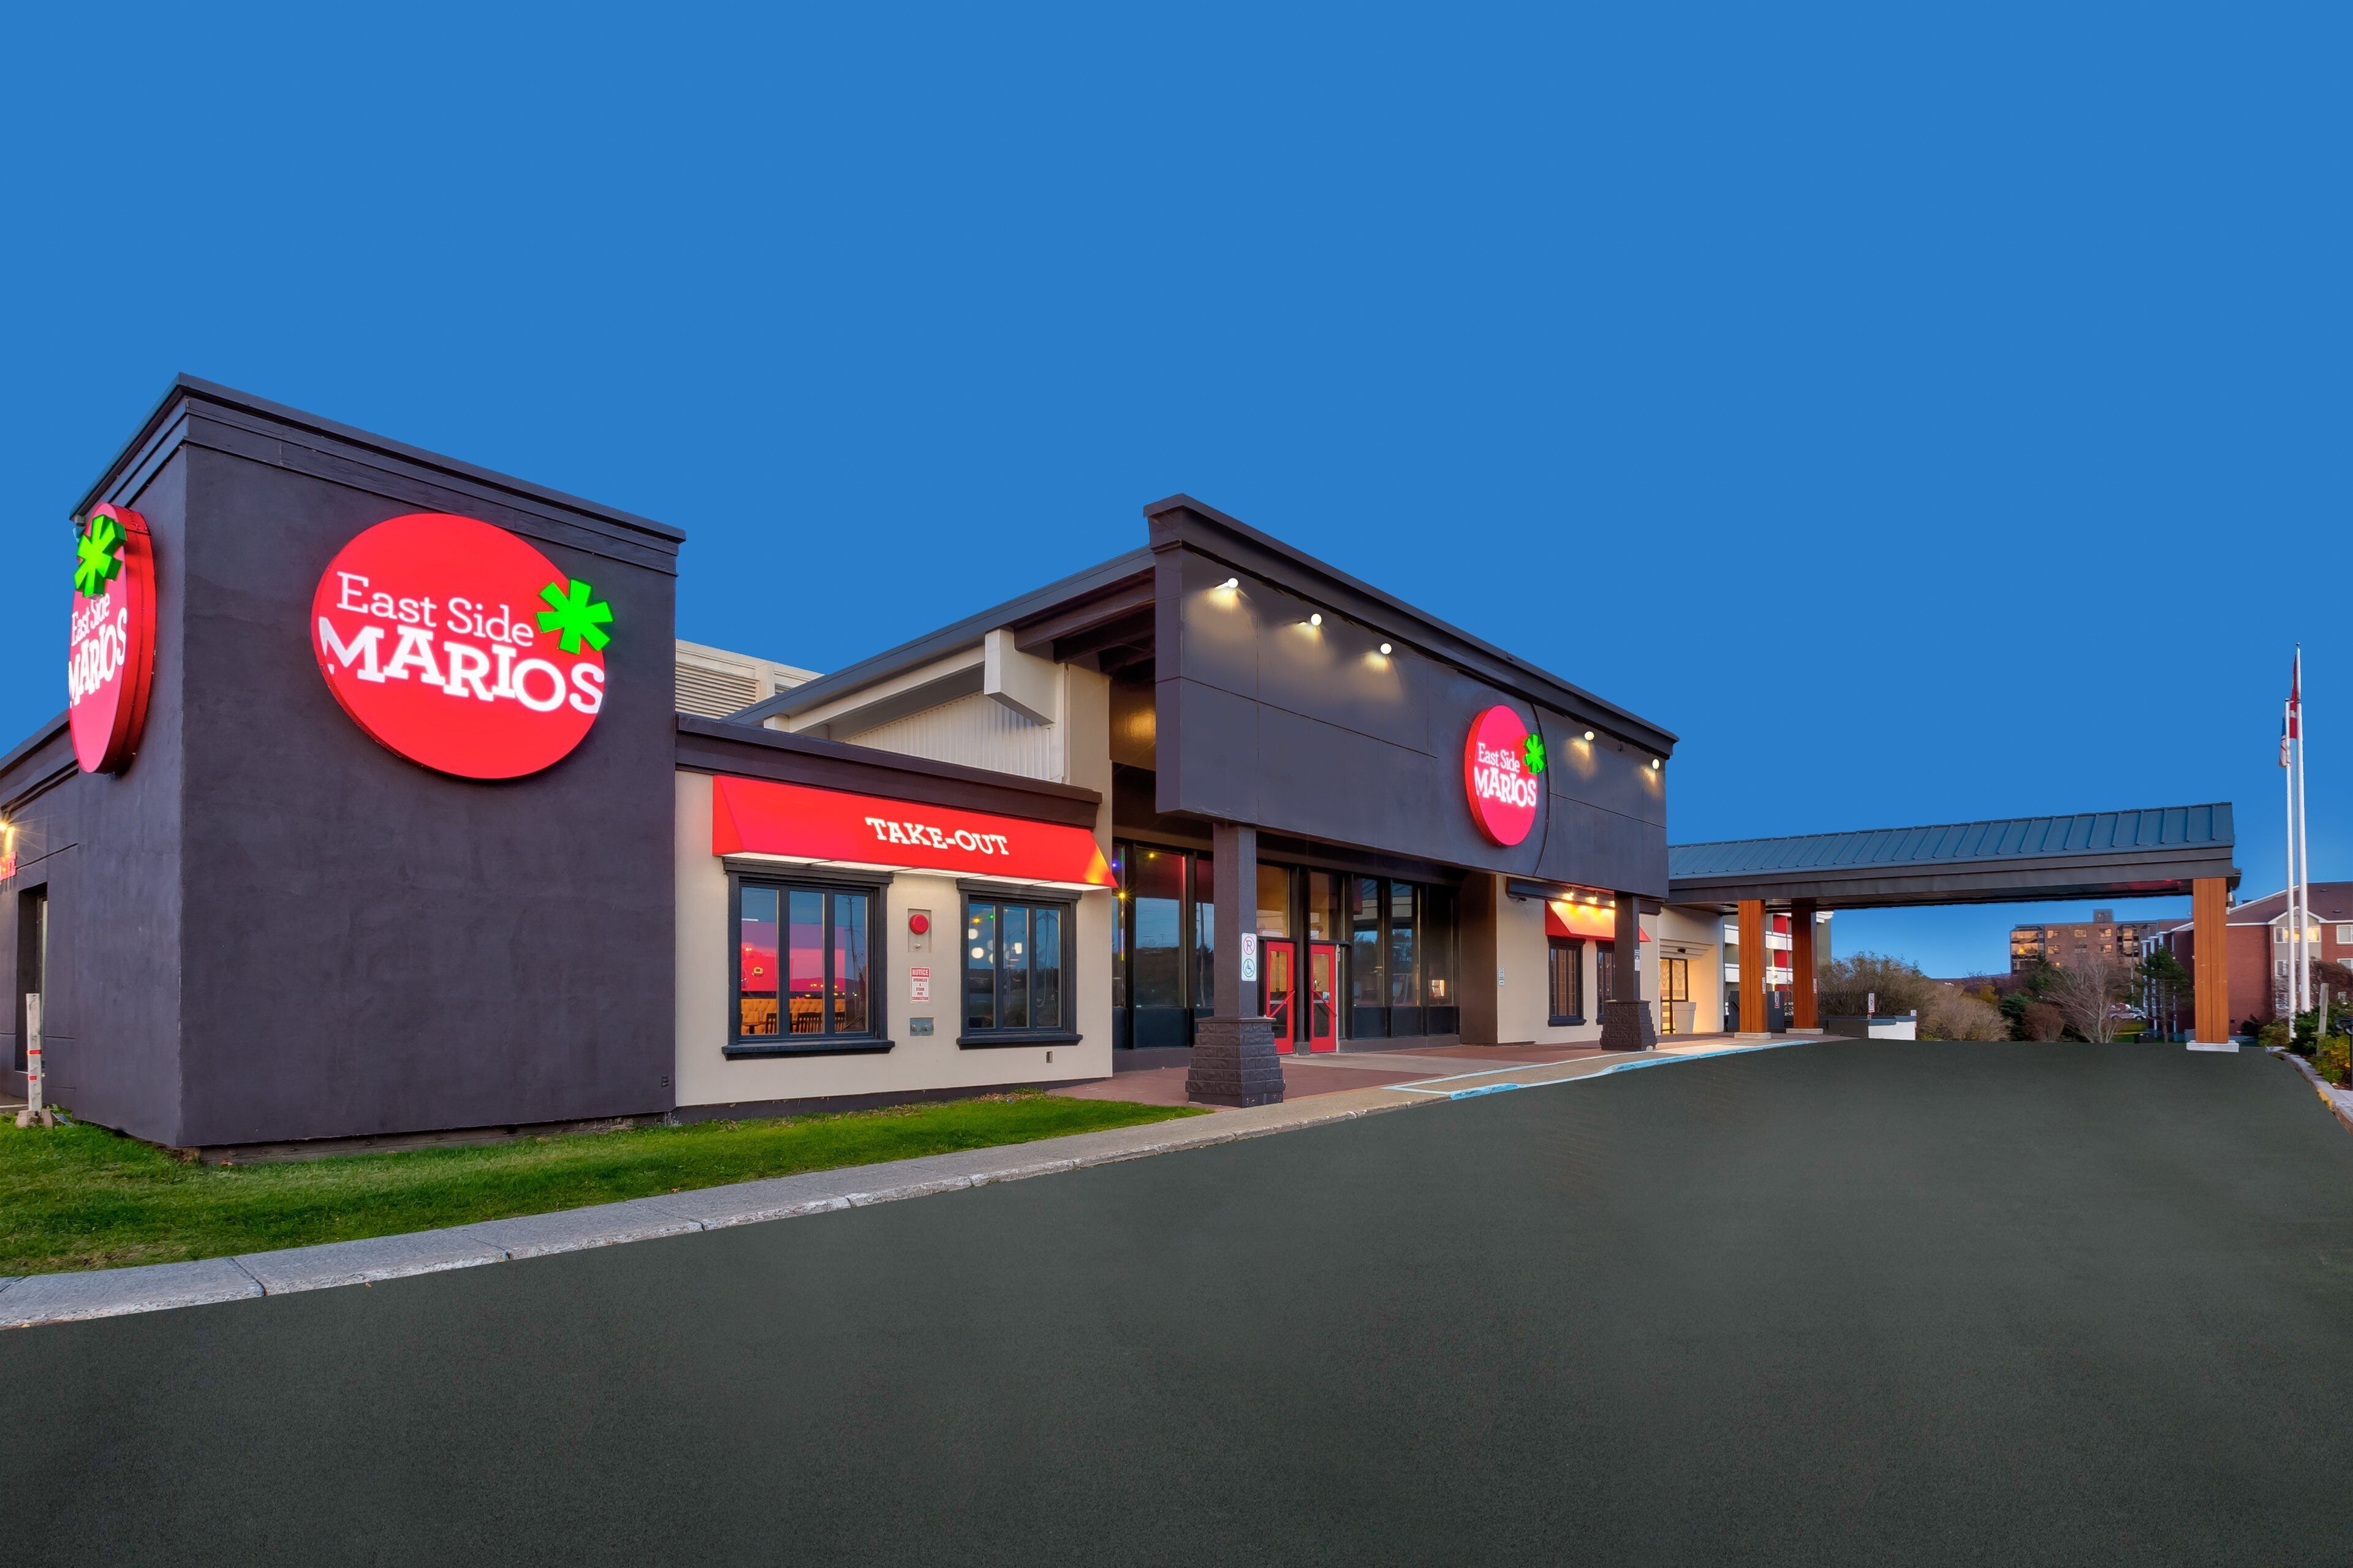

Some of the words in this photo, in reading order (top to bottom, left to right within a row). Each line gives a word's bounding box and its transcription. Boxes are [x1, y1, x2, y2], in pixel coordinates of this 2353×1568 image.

[71, 607, 90, 647] East
[337, 571, 437, 628] East
[447, 597, 534, 646] Side
[68, 607, 127, 709] MARIOS
[319, 616, 605, 714] MARIOS
[1477, 741, 1499, 767] East
[1500, 749, 1520, 773] Side
[1474, 766, 1537, 808] MARIOS
[865, 817, 1010, 855] TAKE-OUT
